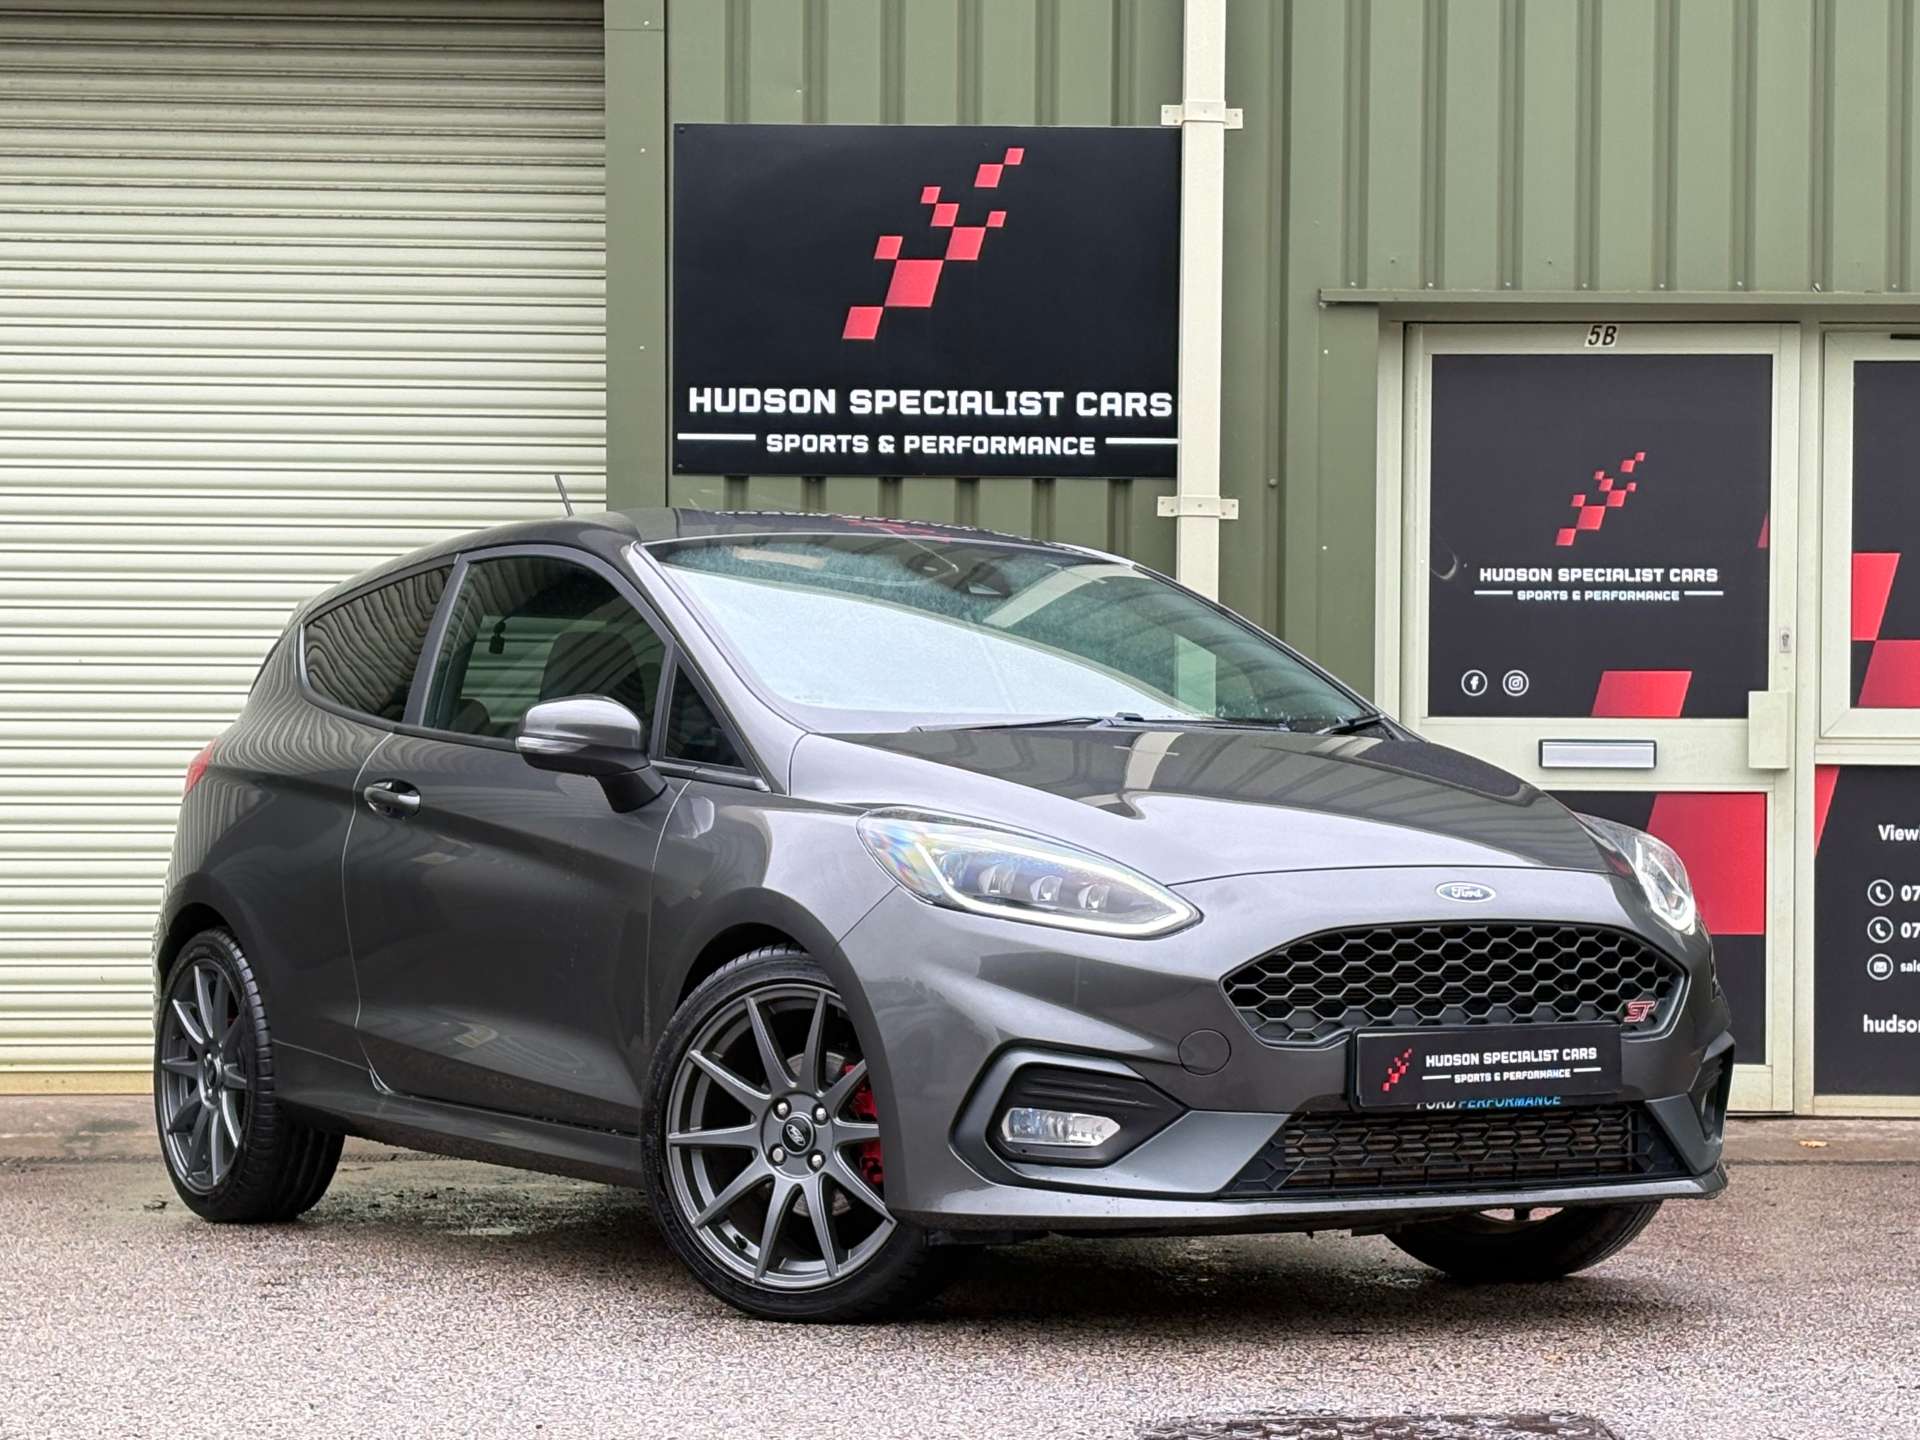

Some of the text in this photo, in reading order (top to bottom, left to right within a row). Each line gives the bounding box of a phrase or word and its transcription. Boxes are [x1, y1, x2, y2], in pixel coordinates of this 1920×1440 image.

[1588, 324, 1617, 346] 5B
[689, 387, 1173, 417] HUDSON SPECIALIST CARS
[766, 433, 1096, 456] SPORTS & PERFORMANCE
[1479, 567, 1719, 583] HUDSON SPECIALIST CARS
[1516, 589, 1680, 602] SPORTS & PERFORMANCE
[1878, 823, 1920, 841] View
[1900, 884, 1920, 901] 07
[1900, 921, 1920, 939] 07
[1624, 1000, 1655, 1022] ST
[1863, 1013, 1920, 1033] hudso
[1425, 1047, 1598, 1067] HUDSON SPECIALIST CARS
[1454, 1072, 1492, 1083] SPORTS
[1503, 1068, 1571, 1081] PERFORMANCE
